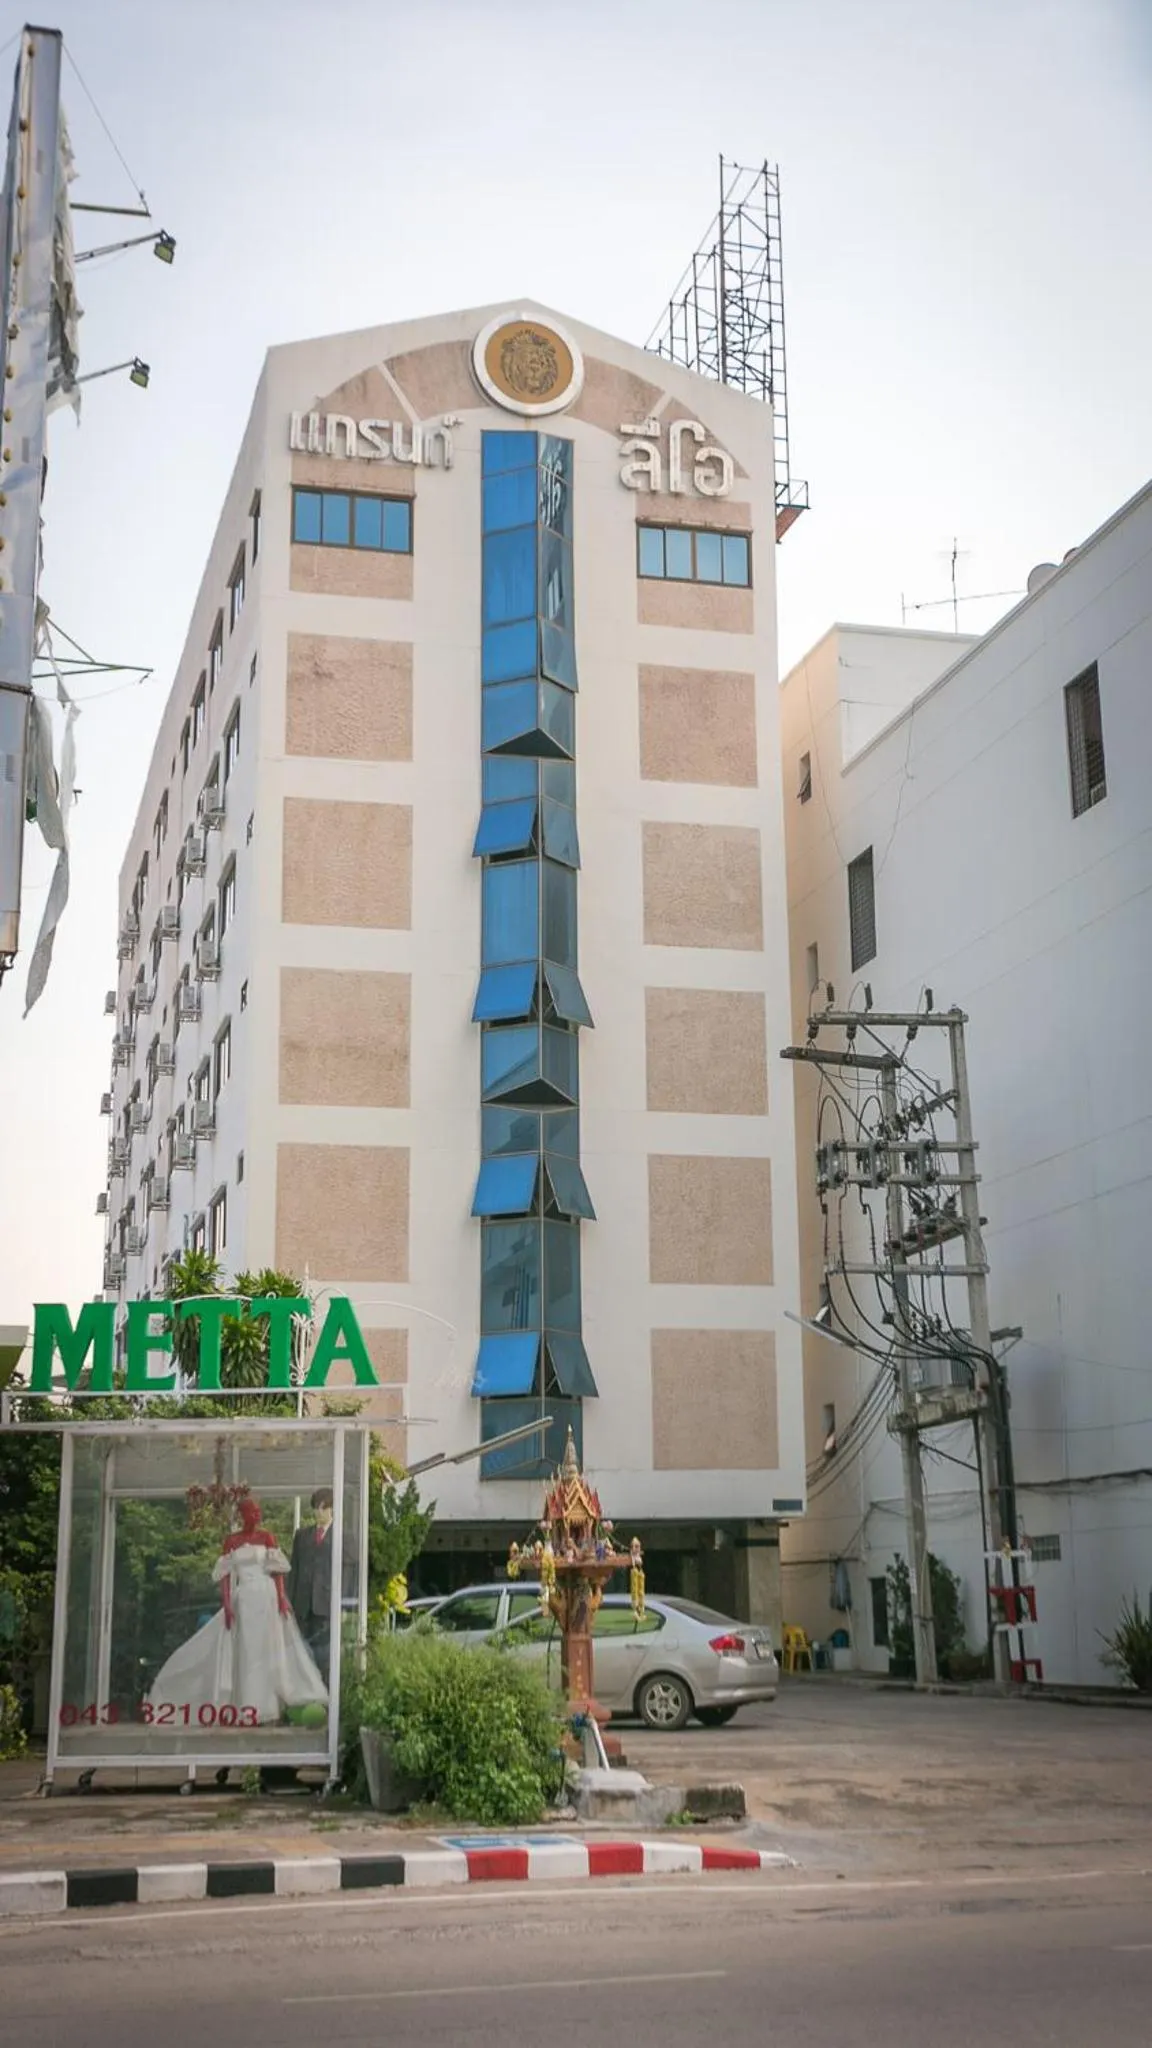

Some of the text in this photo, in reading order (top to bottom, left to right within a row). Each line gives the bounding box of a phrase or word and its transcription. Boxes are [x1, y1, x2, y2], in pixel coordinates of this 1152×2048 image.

[620, 416, 734, 497] ลีโอ
[30, 1296, 380, 1393] METTA
[58, 1703, 119, 1726] 043
